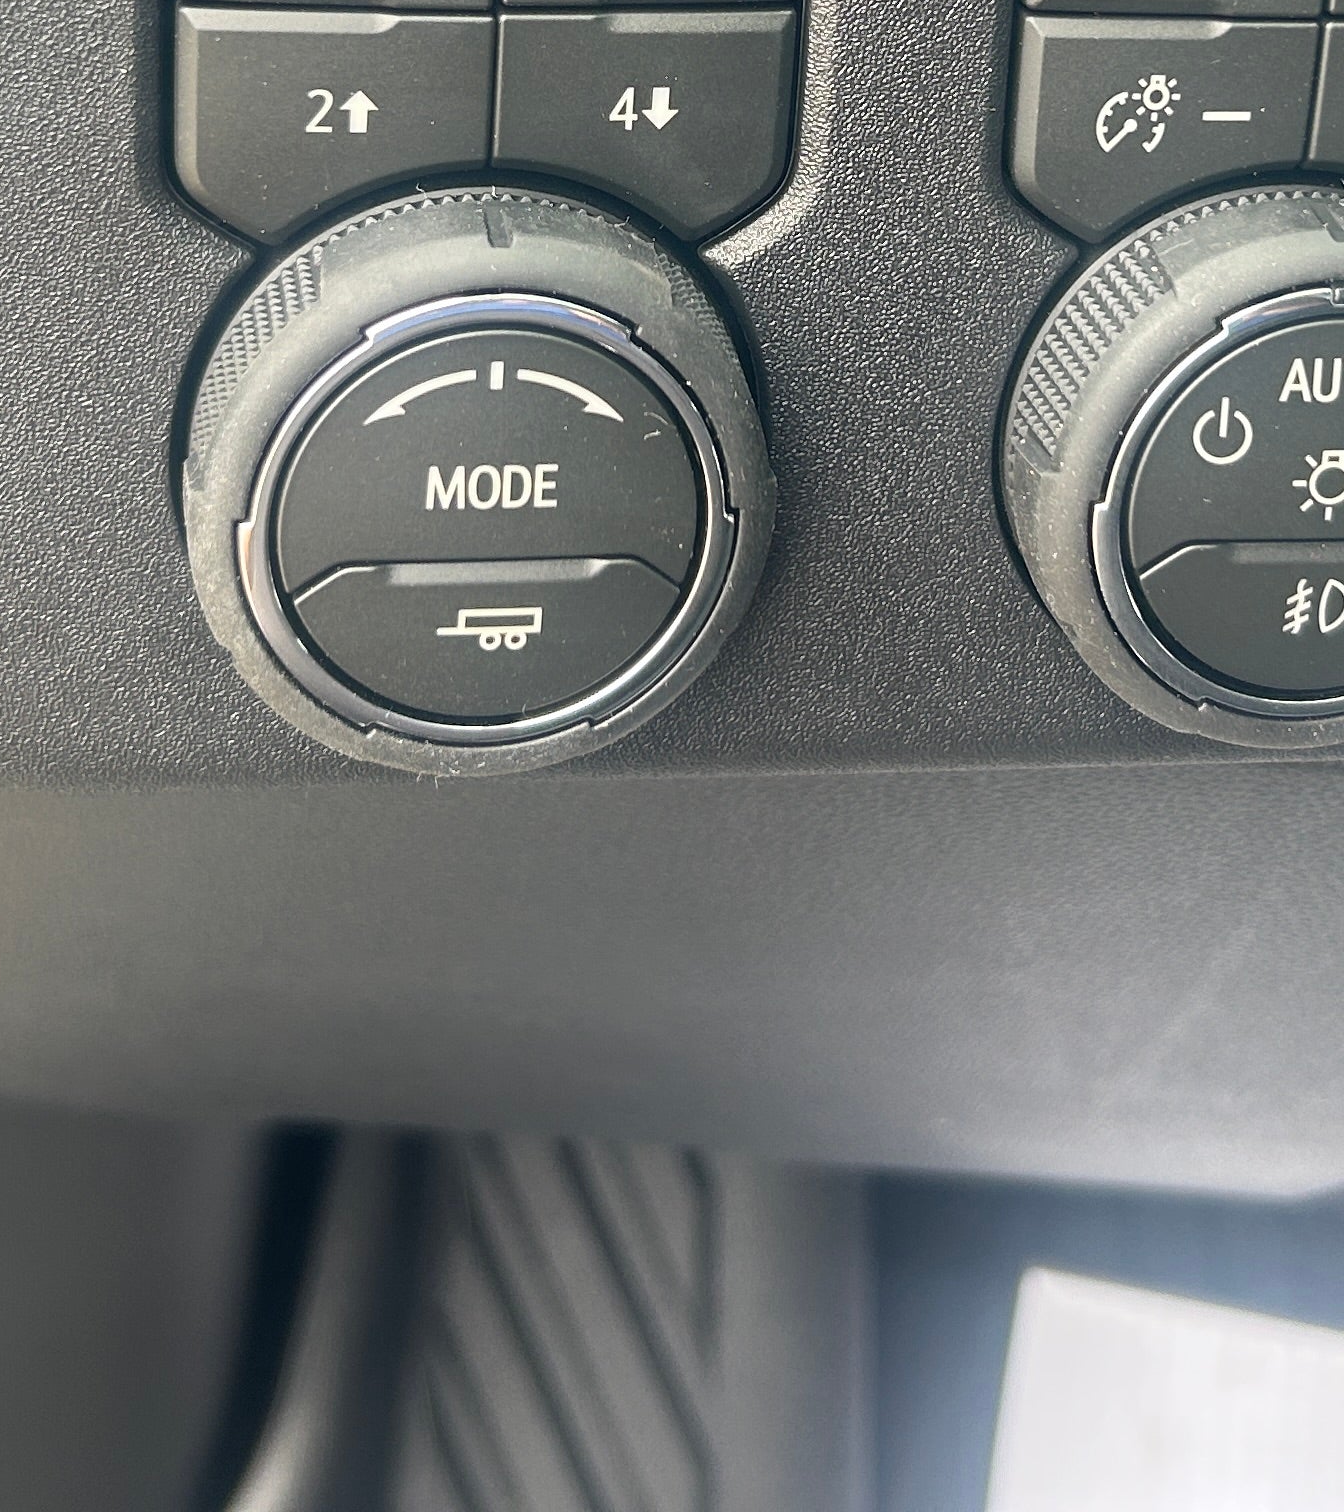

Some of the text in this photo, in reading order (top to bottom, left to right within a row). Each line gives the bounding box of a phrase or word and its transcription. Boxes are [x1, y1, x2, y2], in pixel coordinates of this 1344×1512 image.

[305, 88, 334, 133] 2
[608, 86, 639, 131] 4
[425, 463, 559, 510] MODE
